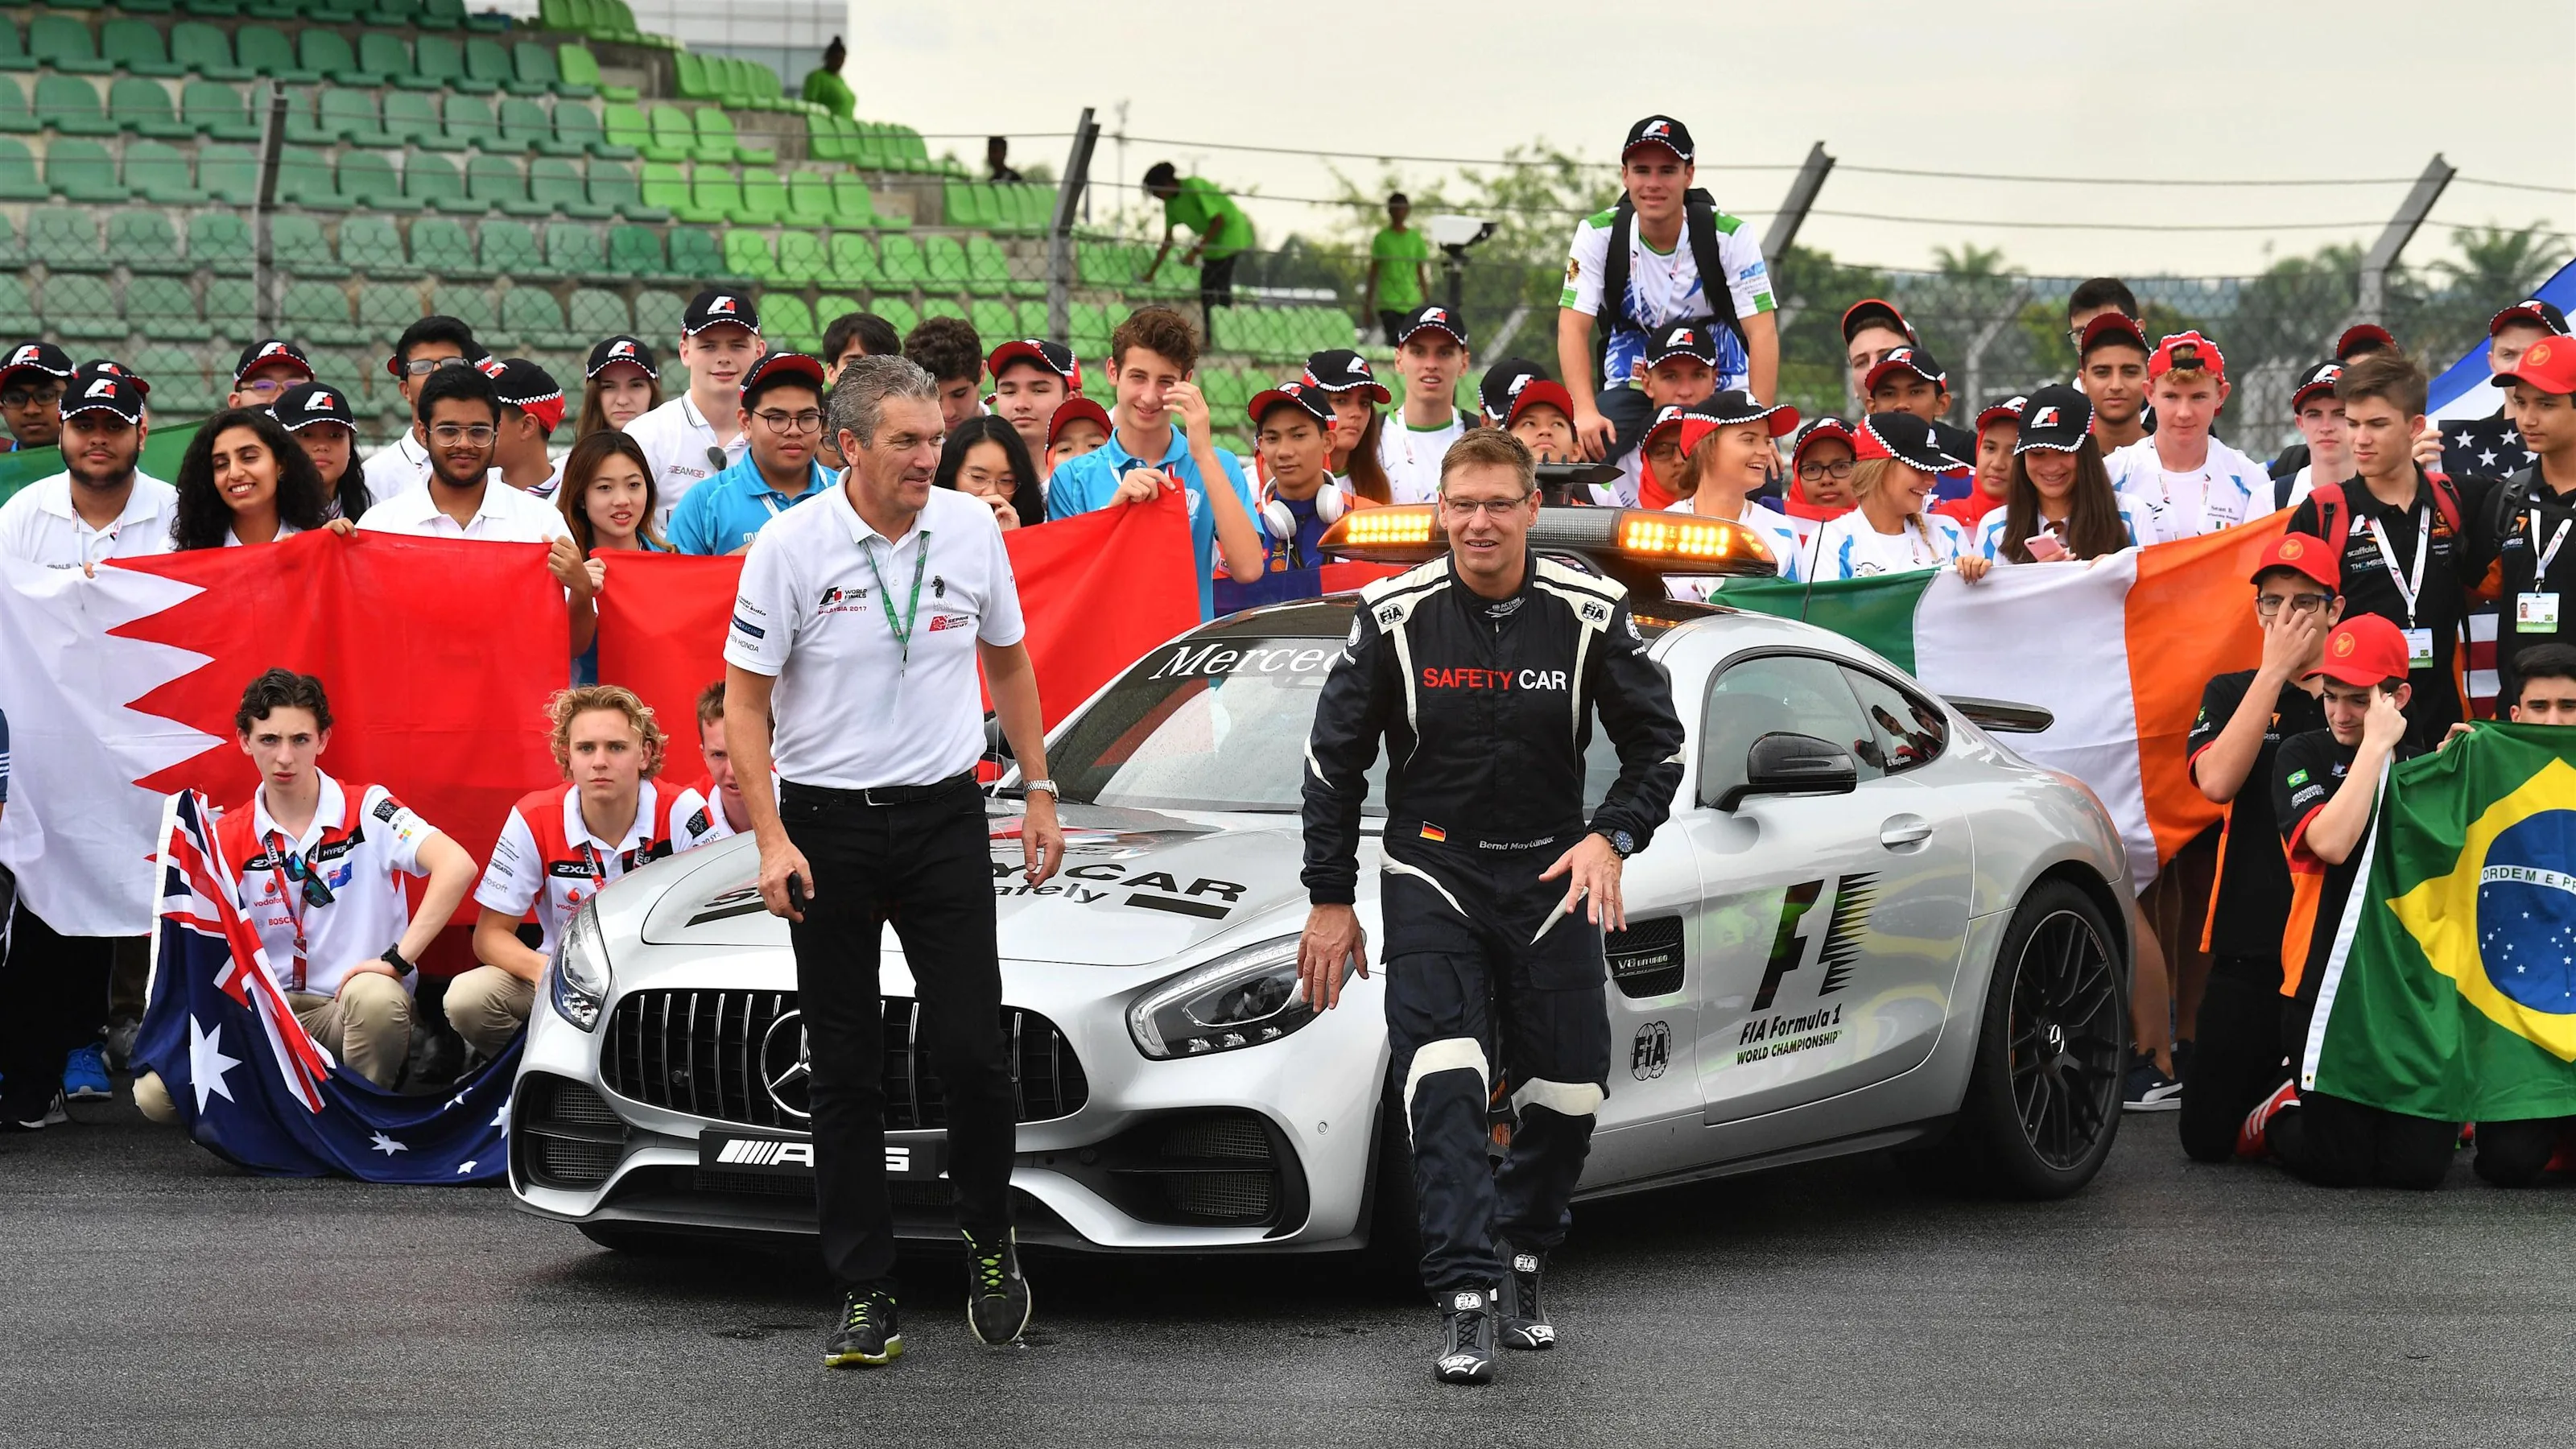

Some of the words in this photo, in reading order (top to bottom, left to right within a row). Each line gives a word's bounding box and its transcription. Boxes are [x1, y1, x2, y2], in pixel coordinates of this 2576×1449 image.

[2347, 545, 2377, 557] scaffold
[737, 638, 759, 654] HONDA
[1422, 668, 1514, 691] SAFETY
[1518, 669, 1567, 691] CAR
[1479, 840, 1509, 850] Bernd
[1064, 864, 1248, 903] CAR
[2483, 867, 2537, 882] ORDEM
[2545, 873, 2554, 885] E
[995, 882, 1111, 904] afely
[254, 897, 284, 908] vodafon
[1618, 958, 1636, 970] V8
[1637, 955, 1669, 967] BITURBO
[1739, 1018, 1765, 1046] FIA
[1770, 1008, 1830, 1039] Formula
[1832, 1003, 1843, 1025] 1
[1736, 1050, 1769, 1066] WORLD
